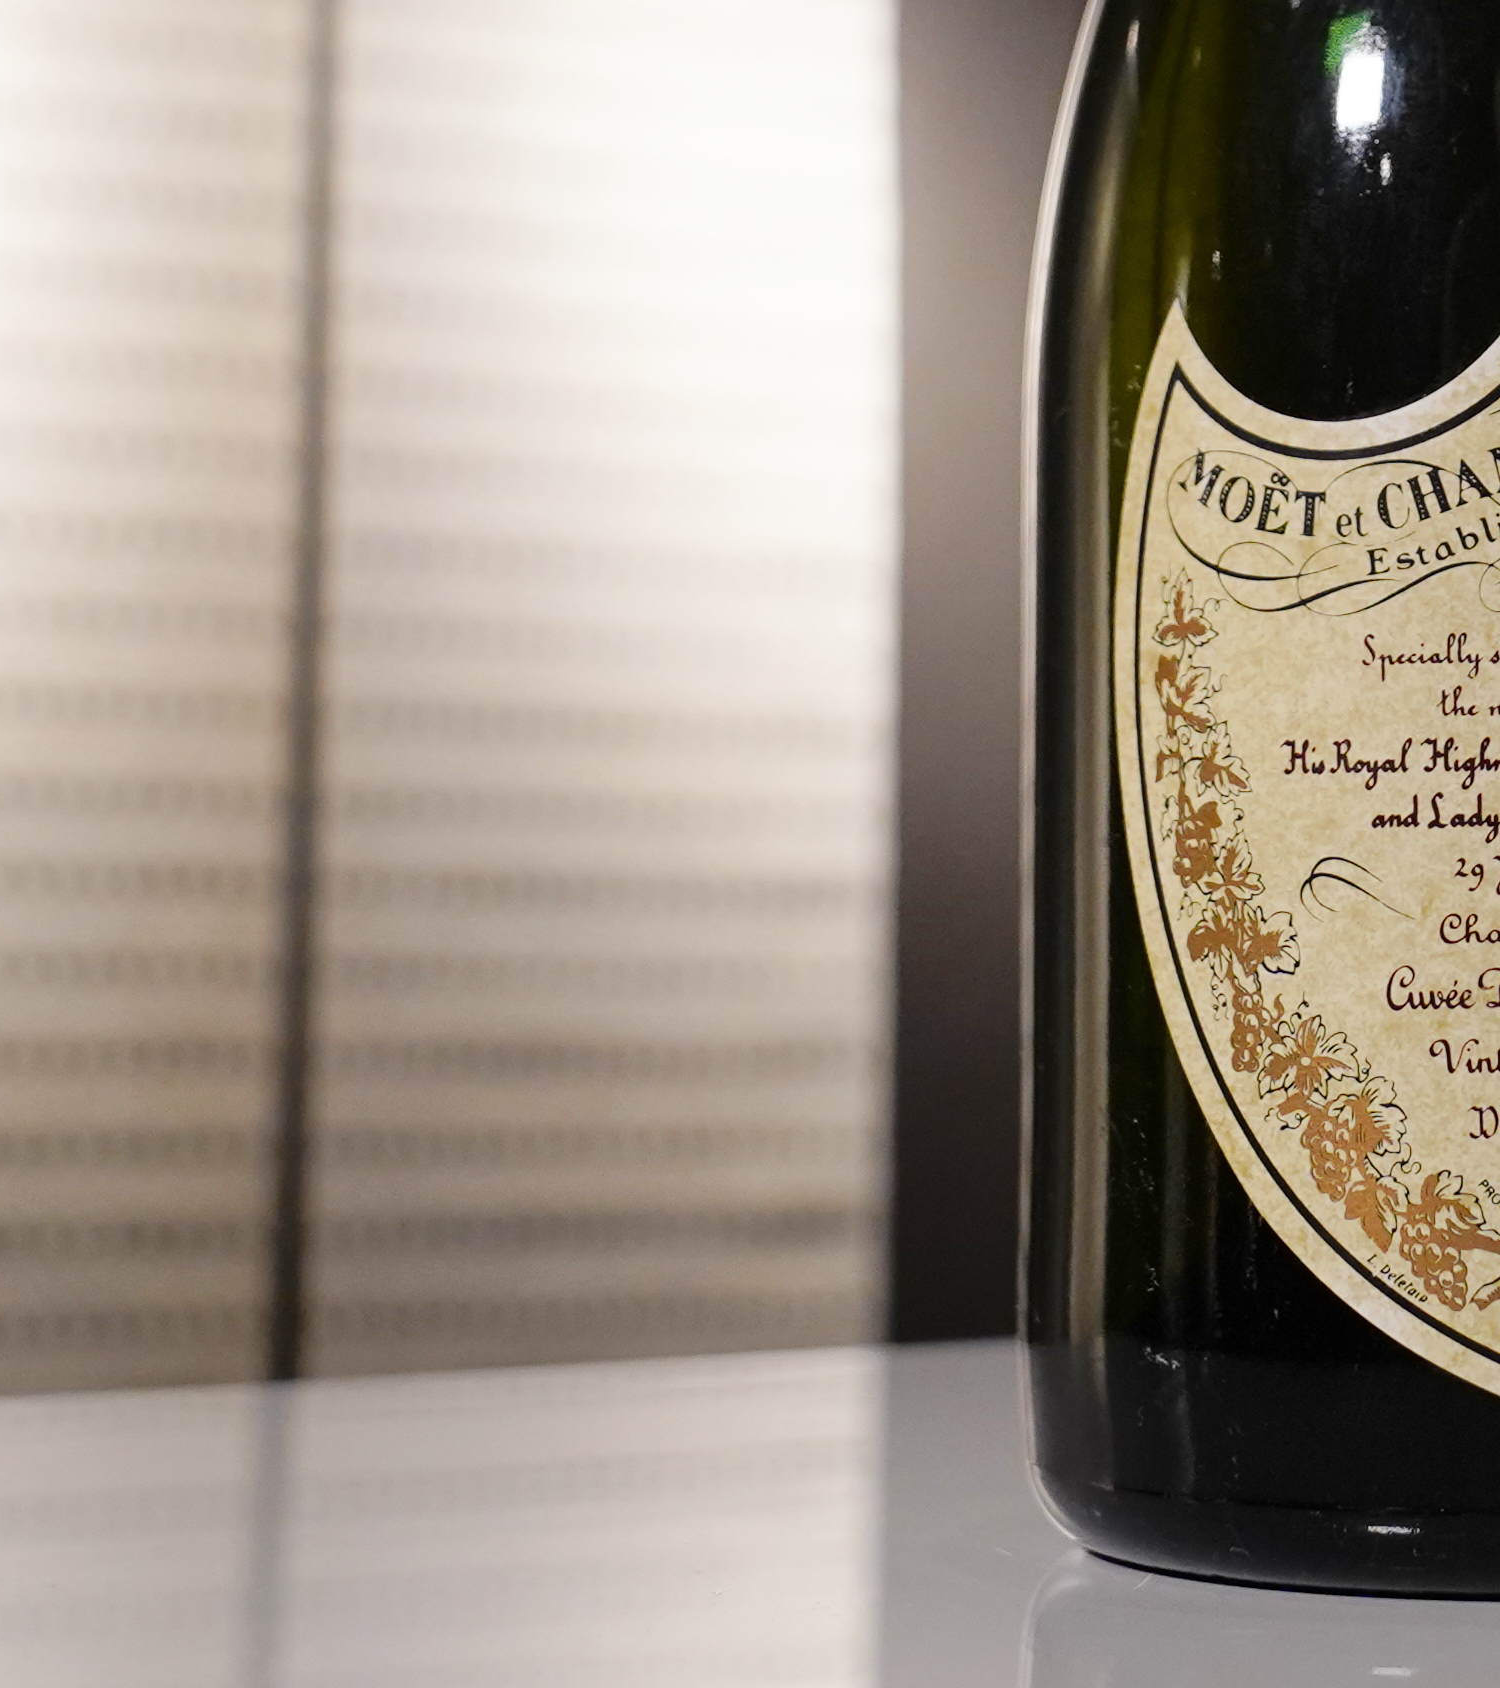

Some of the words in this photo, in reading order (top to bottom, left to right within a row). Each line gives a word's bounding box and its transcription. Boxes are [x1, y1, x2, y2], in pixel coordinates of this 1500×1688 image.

[1178, 448, 1326, 536] MOËT
[1336, 506, 1368, 538] et
[1362, 633, 1481, 681] Specially
[1441, 686, 1478, 716] the
[1282, 740, 1325, 775] His
[1328, 739, 1409, 789] Royal
[1371, 794, 1419, 829] and
[1428, 792, 1500, 842] Lady
[1453, 857, 1485, 891] 29
[1386, 965, 1474, 1010] Cuvée
